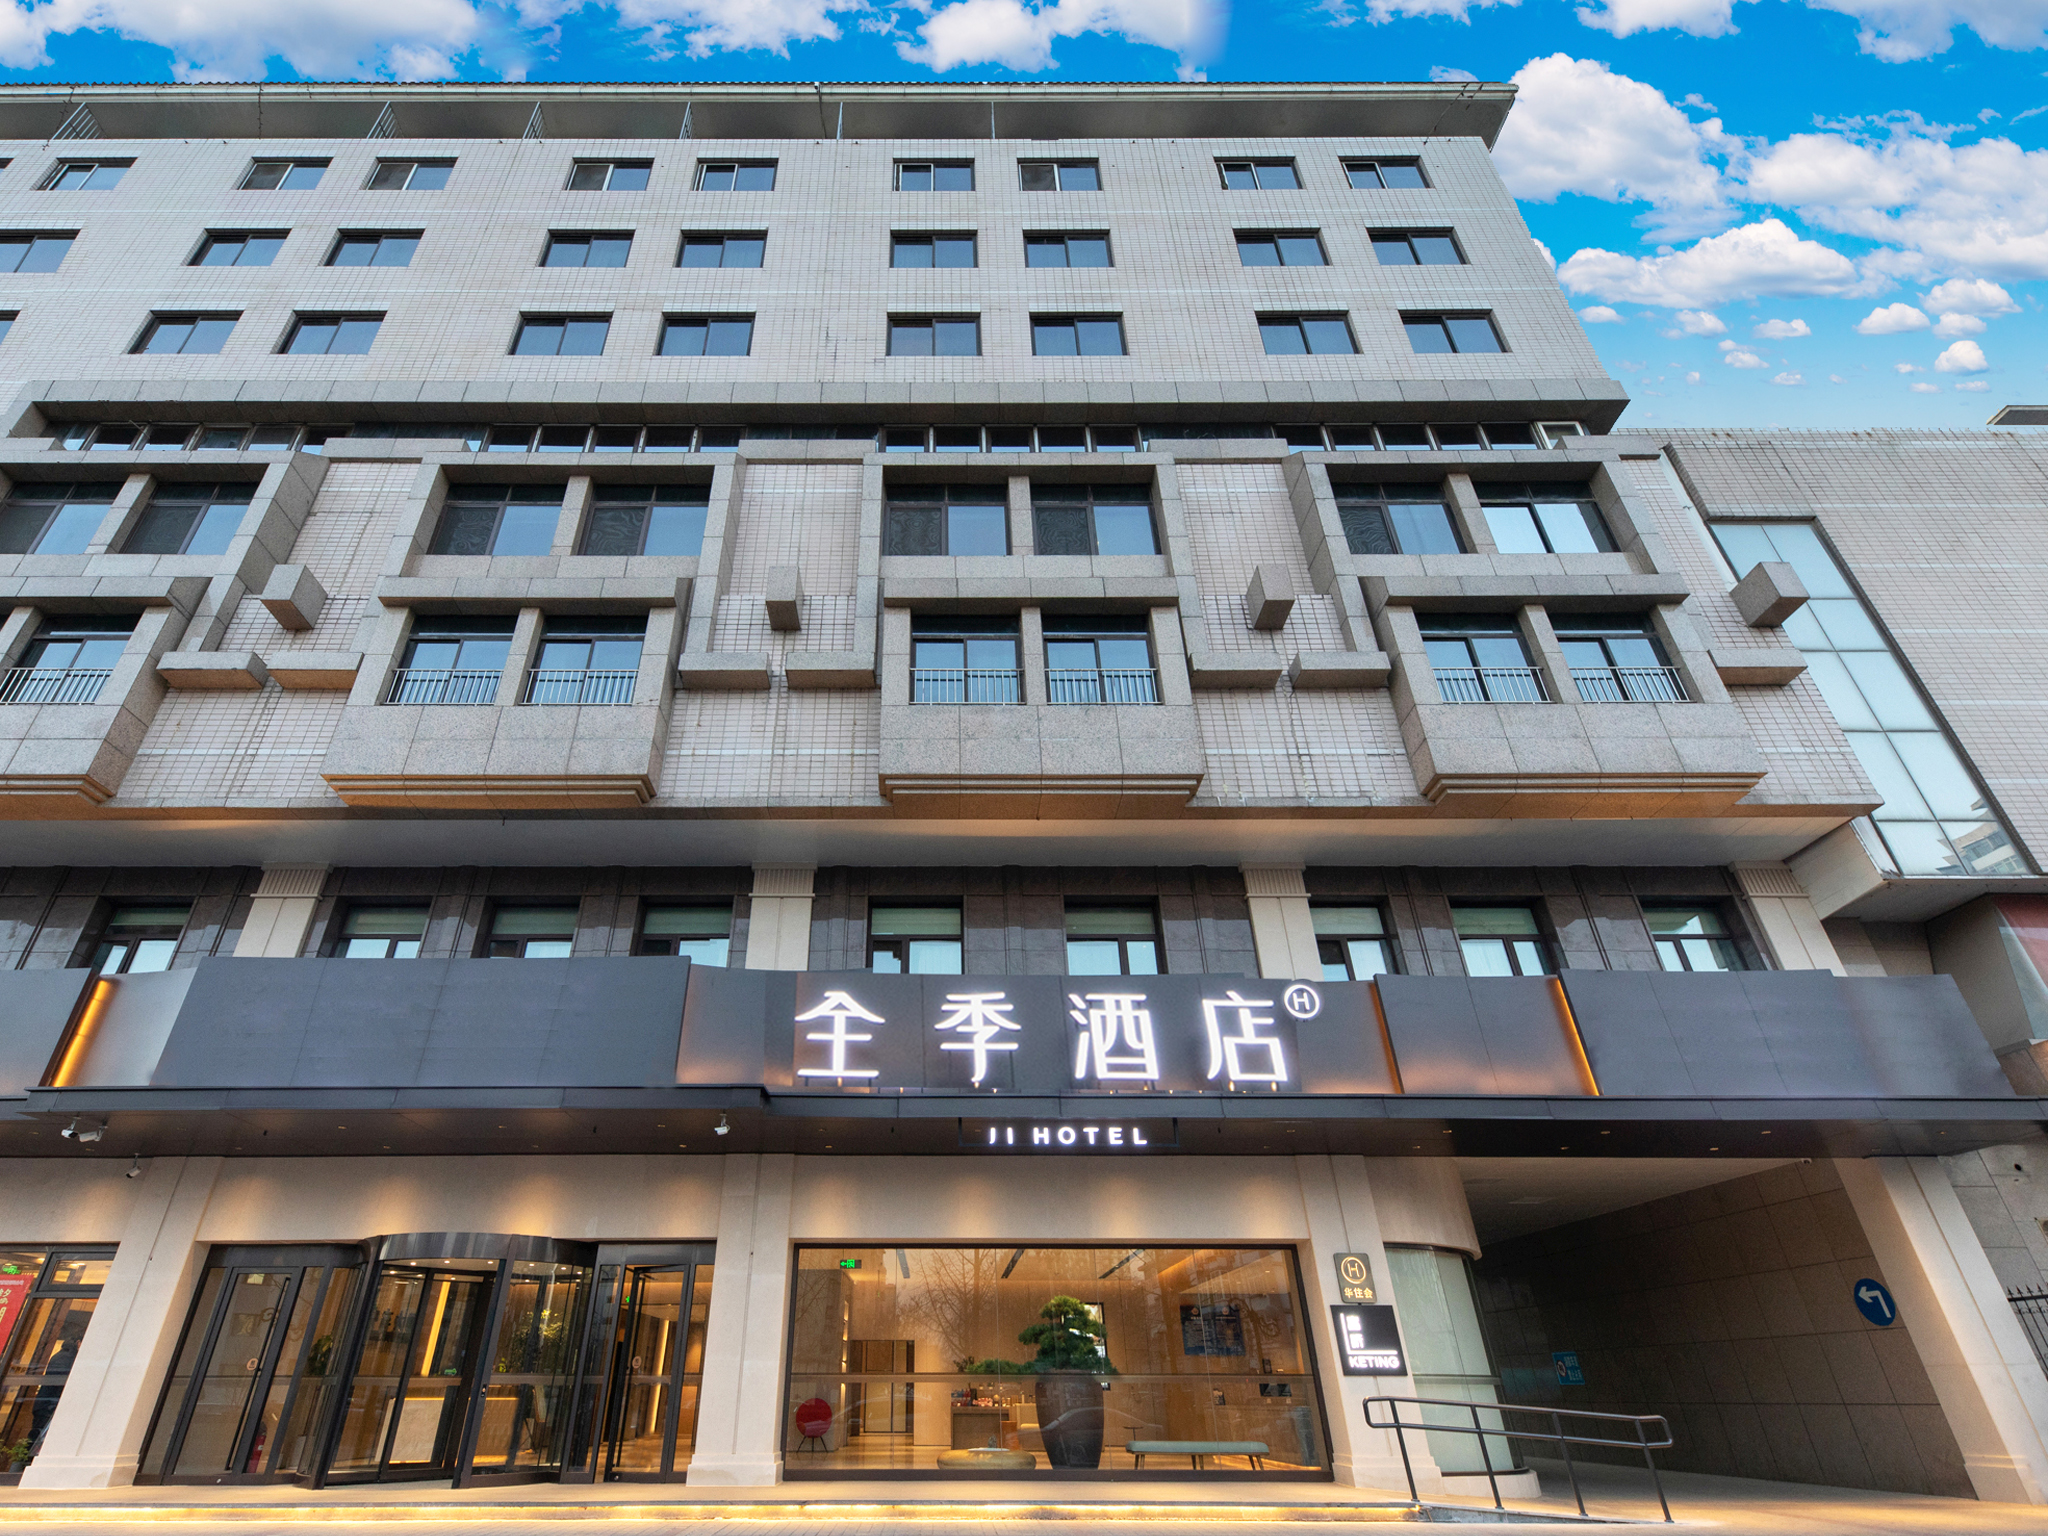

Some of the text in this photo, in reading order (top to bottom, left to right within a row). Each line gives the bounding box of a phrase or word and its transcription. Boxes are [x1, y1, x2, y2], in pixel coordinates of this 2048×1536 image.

[794, 990, 1289, 1083] 全季酒店
[989, 1126, 1148, 1145] JI HOTEL
[1344, 1287, 1373, 1299] 华住会
[1348, 1355, 1400, 1369] KETING
